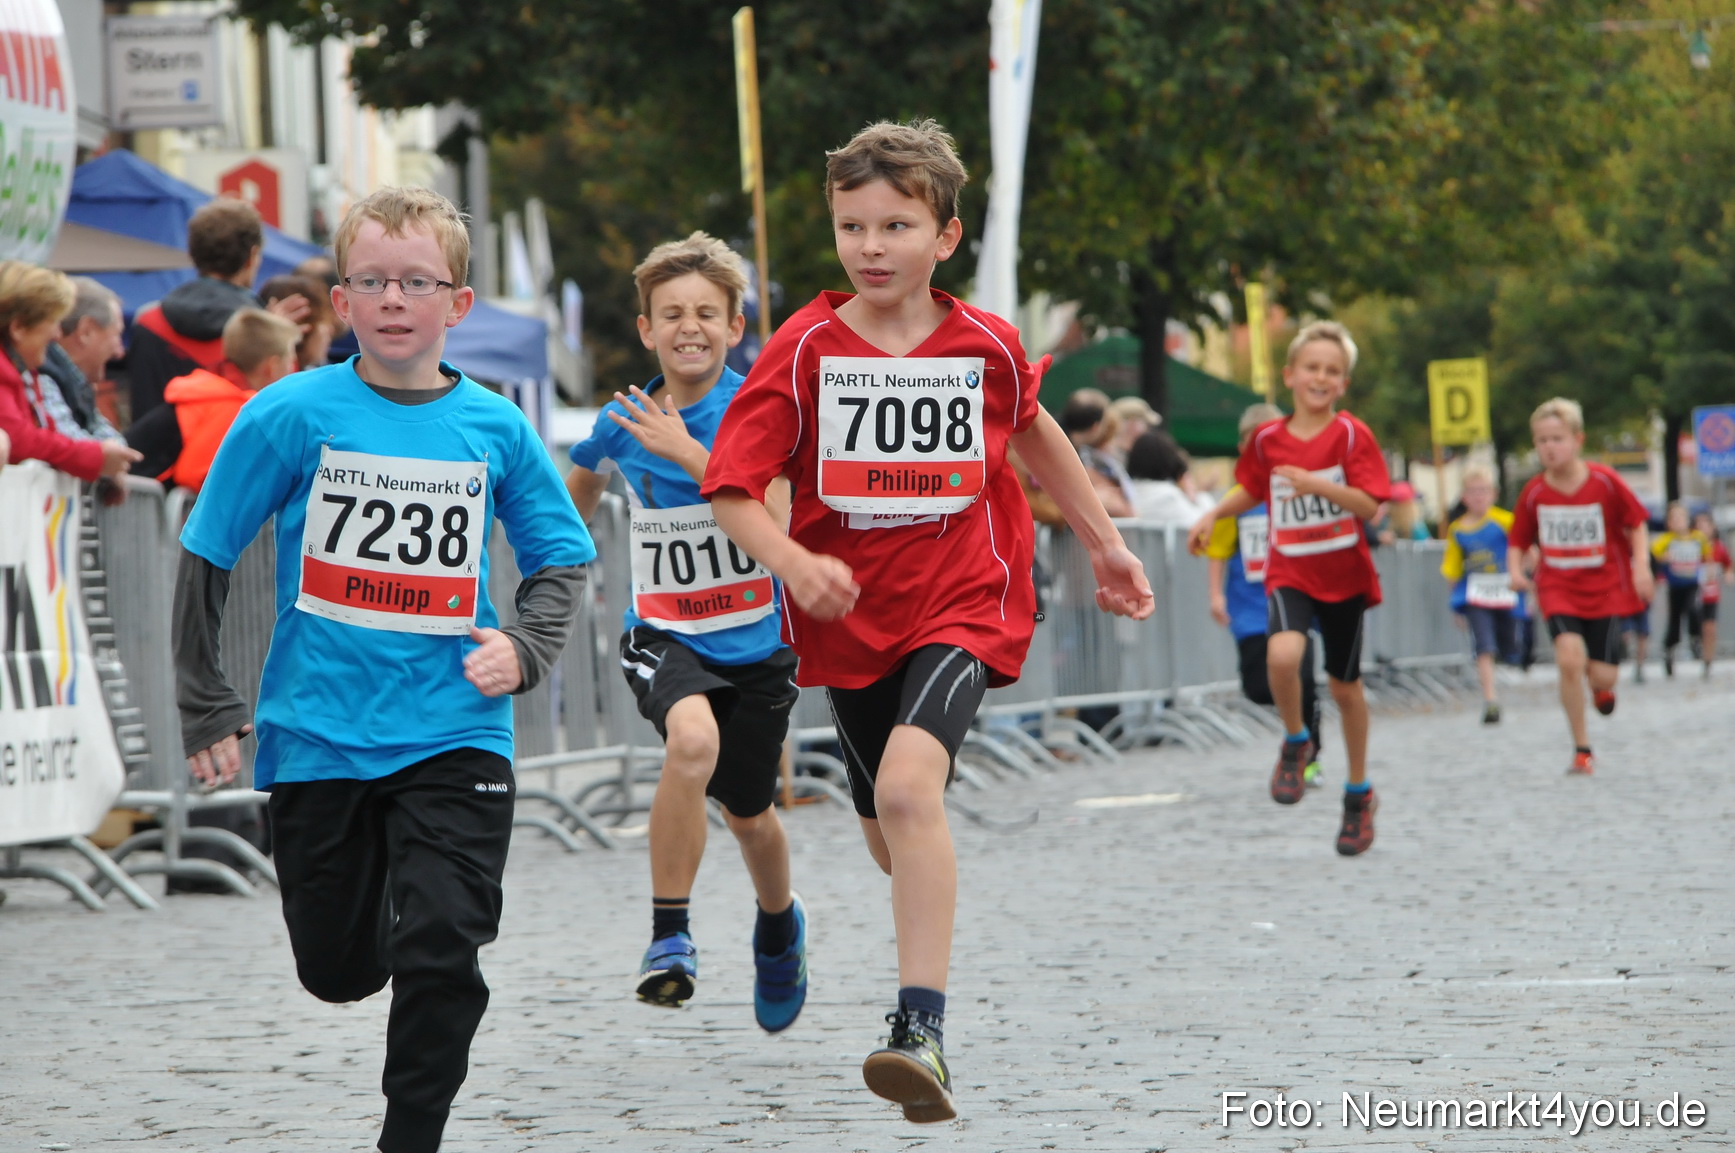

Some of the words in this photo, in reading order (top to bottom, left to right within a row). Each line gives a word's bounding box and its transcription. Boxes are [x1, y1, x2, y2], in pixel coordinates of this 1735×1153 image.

[824, 373, 880, 388] PARTL
[885, 373, 961, 388] Neumarkt
[1447, 386, 1473, 423] D
[838, 396, 973, 453] 7098
[826, 448, 833, 458] 6
[973, 448, 979, 458] K
[317, 464, 371, 487] PARTL
[376, 473, 461, 495] Neumarkt
[867, 469, 942, 496] Philipp
[322, 493, 469, 568] 7238
[632, 521, 668, 534] PARTL
[307, 544, 314, 555] 6
[467, 563, 473, 574] K
[345, 575, 430, 613] Philipp
[677, 593, 733, 616] Moritz
[488, 782, 508, 793] JAKO
